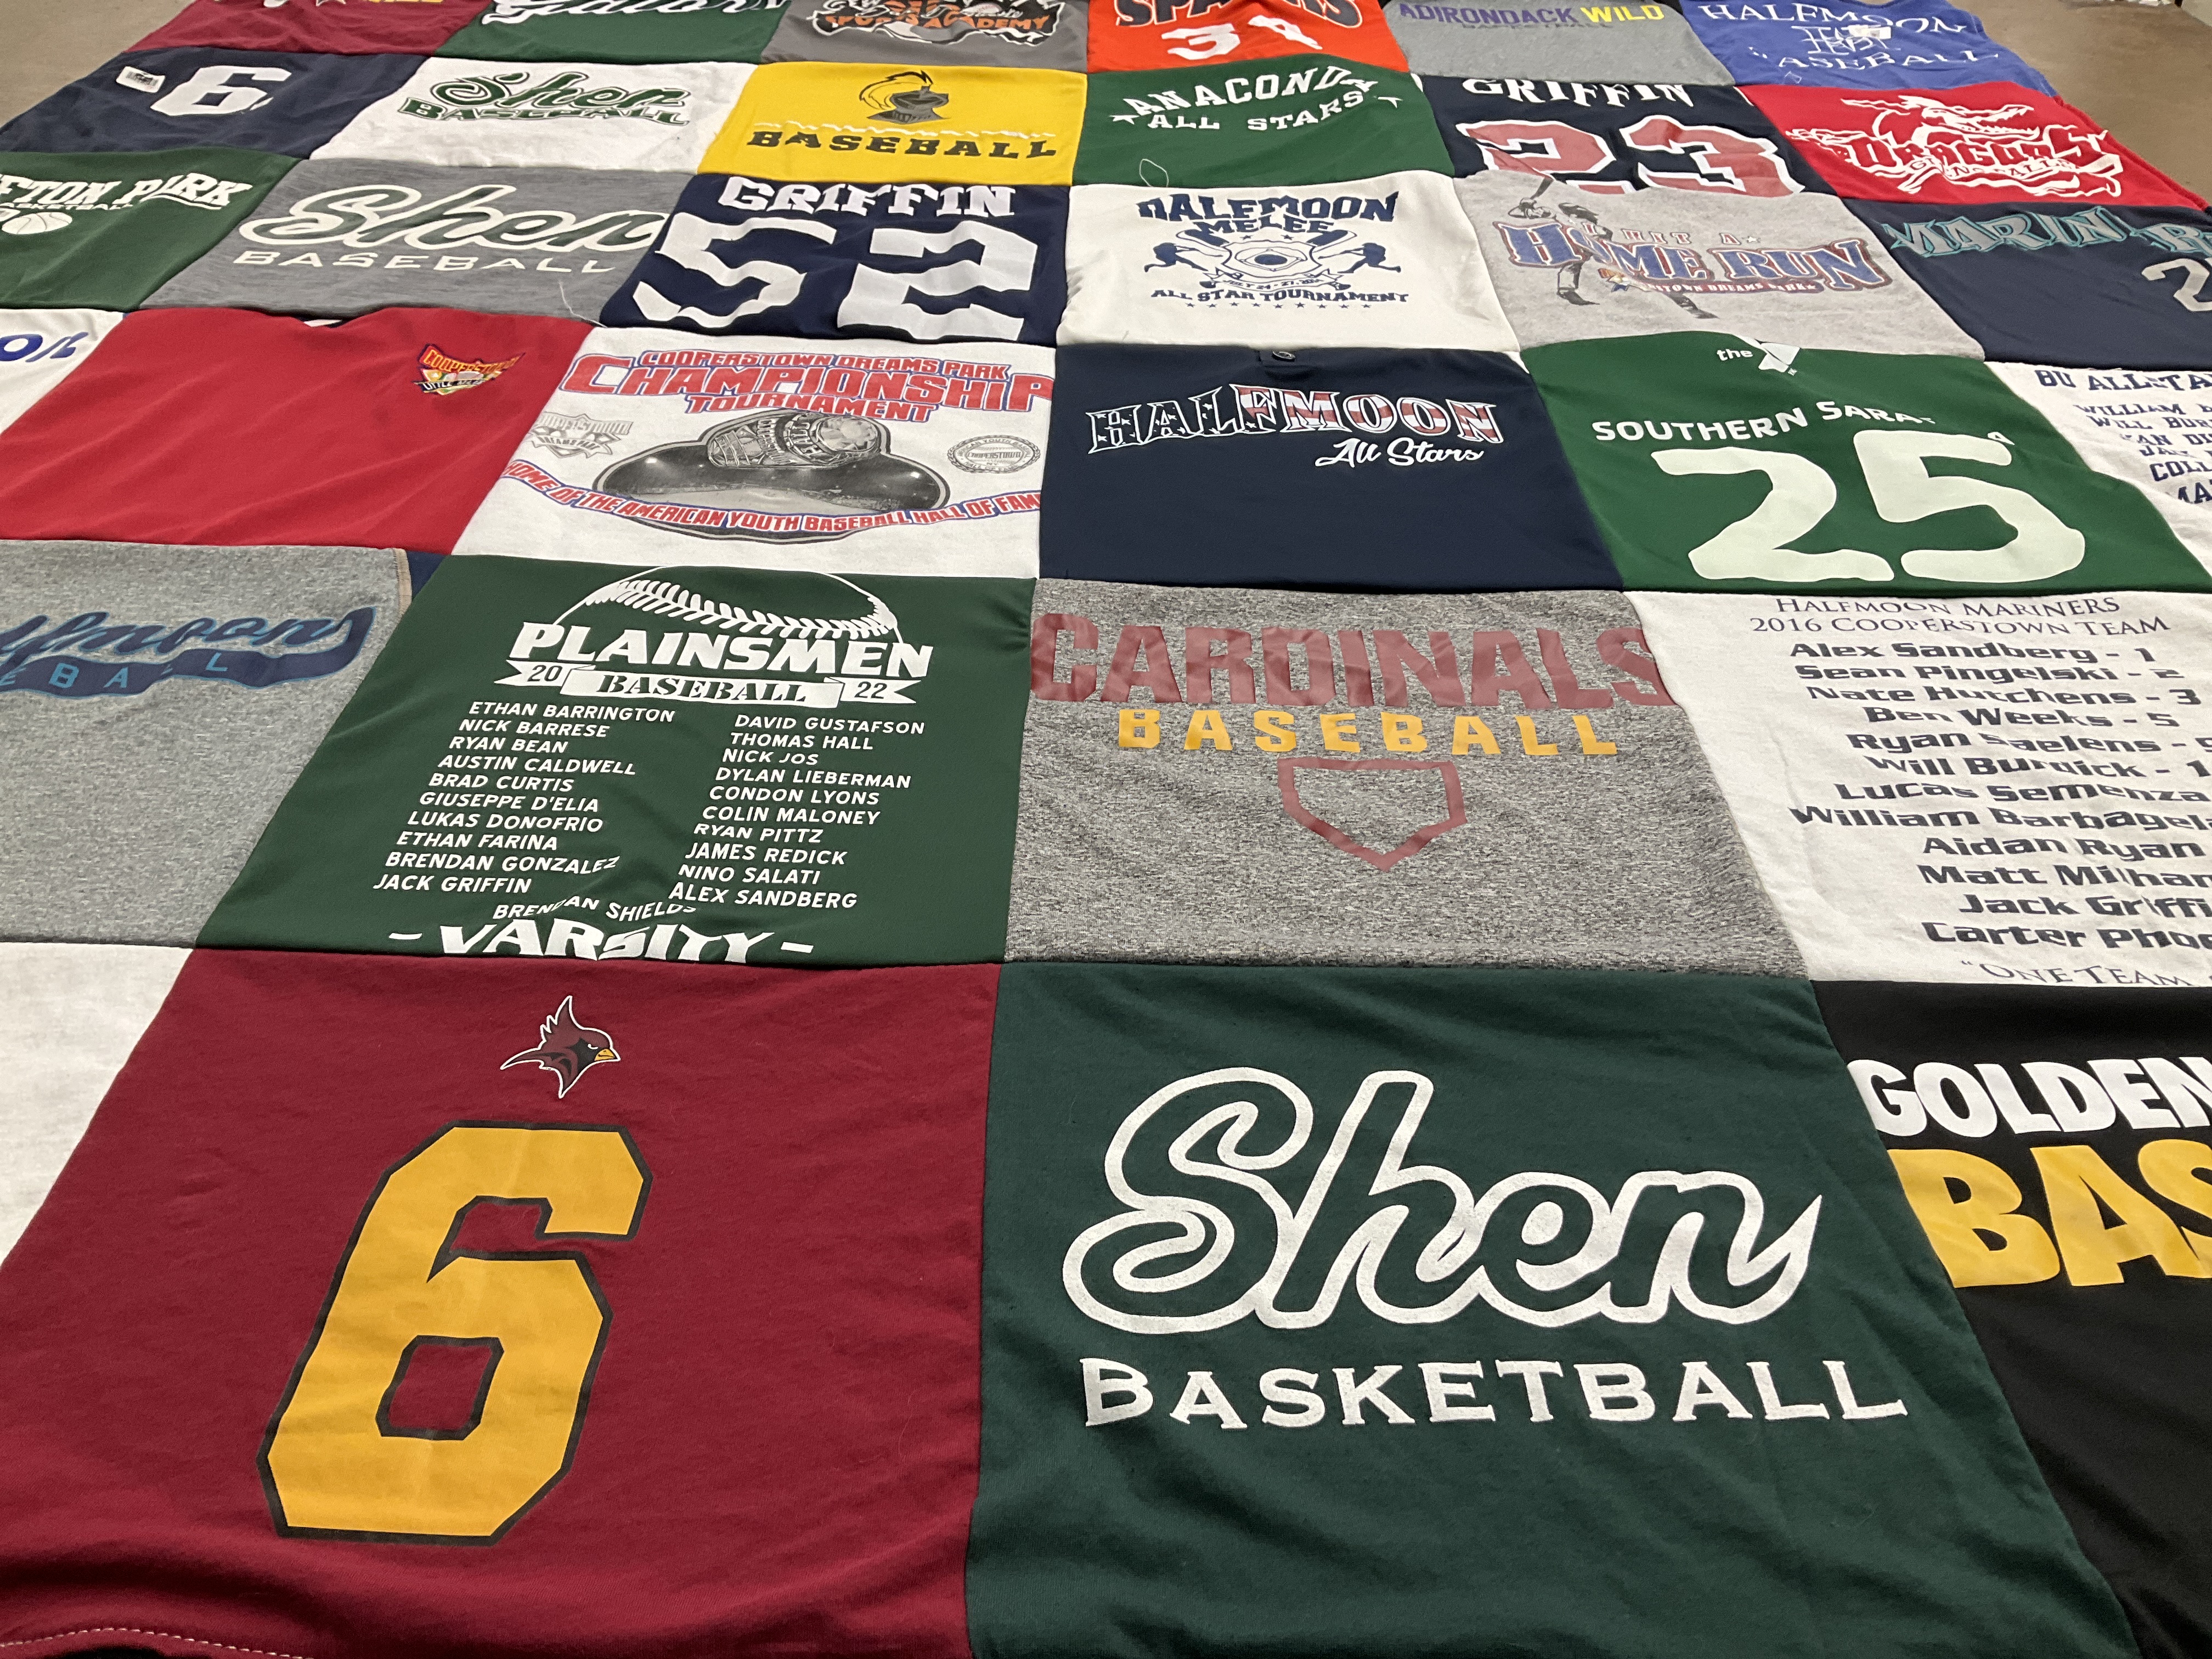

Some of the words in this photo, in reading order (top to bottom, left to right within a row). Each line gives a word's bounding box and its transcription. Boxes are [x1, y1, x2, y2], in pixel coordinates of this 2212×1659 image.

[1400, 3, 1579, 24] ADIRONDACK
[1581, 5, 1665, 22] WILD
[1697, 3, 1967, 33] HALFMOON
[150, 65, 292, 116] 6
[430, 71, 691, 109] Shen
[1462, 77, 1695, 107] GRIFFIN
[1148, 114, 1220, 129] ALL
[1248, 91, 1364, 131] STARS
[747, 131, 1057, 159] BASEBALL
[1455, 115, 1806, 198] 23
[0, 173, 122, 204] FTON
[718, 176, 1015, 218] GRIFFIN
[239, 184, 668, 252] Shen
[1193, 214, 1334, 234] MELEE
[1620, 228, 1692, 245] HIT
[233, 251, 618, 273] BASEBALL
[1708, 238, 1893, 291] RUN
[633, 212, 1038, 341] 52
[1708, 282, 1764, 292] DREAMS
[1150, 289, 1192, 301] ALL
[1198, 289, 1255, 302] STAR
[1260, 289, 1409, 302] TOURNAMENT
[639, 349, 835, 367] COOPERSTOWN
[835, 354, 939, 374] DREAMS
[943, 360, 1012, 380] PARK
[1717, 348, 1753, 361] the
[559, 353, 1054, 412] CHAMPIONSHIP
[685, 392, 939, 423] TOURNAMENT
[2073, 403, 2187, 416] WILLIAM
[1086, 383, 1505, 455] HALFMOON
[1592, 407, 1809, 441] SOUTHERN
[2086, 415, 2153, 430] WILL
[1315, 437, 1382, 467] All
[1387, 437, 1484, 466] Stars
[500, 460, 556, 491] HOME
[546, 485, 584, 505] OF
[573, 490, 623, 514] THE
[614, 499, 728, 528] AMERICAN
[726, 510, 801, 532] YOUTH
[803, 510, 910, 533] BASEBALL
[909, 506, 966, 524] HALL
[963, 498, 997, 518] OF
[1651, 430, 2085, 583] 25
[1775, 598, 1953, 615] HALFMOON
[1962, 596, 2121, 617] MARINERS
[1750, 617, 1822, 632] 2016
[1831, 617, 2071, 635] COOPERSTOWN
[2074, 616, 2172, 636] TEAM
[509, 622, 934, 678] PLAINSMEN
[1031, 612, 1681, 709] CARDINALS
[1790, 642, 1885, 658] Alex
[1891, 641, 2098, 663] Sandberg
[2134, 647, 2156, 662] 1
[527, 664, 563, 682] 20
[596, 674, 807, 702] BASEBALL
[854, 680, 888, 700] 22
[1795, 664, 1906, 679] Sean
[1913, 665, 2119, 685] Pingelski
[2149, 668, 2185, 679] 2
[1805, 686, 1915, 702] Nate
[1923, 685, 2137, 705] Hutchens
[2169, 689, 2202, 705] 3
[469, 701, 538, 716] ETHAN
[543, 704, 675, 722] BARRINGTON
[1862, 706, 1954, 723] Ben
[1956, 707, 2114, 727] Weeks
[2146, 712, 2180, 727] 5
[459, 719, 511, 732] NICK
[516, 721, 610, 738] BARRESE
[735, 714, 796, 729] DAVID
[805, 717, 925, 734] GUSTAFSON
[1117, 708, 1617, 756] BASEBALL
[449, 736, 505, 751] RYAN
[511, 738, 568, 753] BEAN
[730, 732, 815, 748] THOMAS
[822, 736, 874, 750] HALL
[1845, 732, 1972, 753] Ryan
[1977, 732, 2162, 752] Saelens
[438, 755, 515, 769] AUSTIN
[524, 758, 636, 775] CALDWELL
[722, 748, 774, 763] NICK
[778, 753, 819, 765] JOS
[1863, 755, 1956, 775] Will
[428, 773, 488, 788] BRAD
[496, 775, 575, 792] CURTIS
[715, 767, 785, 782] DYLAN
[793, 770, 912, 788] LIEBERMAN
[419, 792, 526, 809] GIUSEPPE
[531, 795, 599, 812] D'ELIA
[709, 786, 803, 802] CONDON
[810, 789, 879, 805] LYONS
[1833, 782, 1979, 800] Lucas
[1985, 783, 2211, 802] Semenza
[408, 811, 481, 828] LUKAS
[486, 814, 603, 832] DONOFRIO
[702, 806, 769, 822] COLIN
[776, 808, 881, 825] MALONEY
[1787, 805, 1980, 826] William
[396, 831, 473, 848] ETHAN
[478, 834, 558, 850] FARINA
[693, 823, 752, 839] RYAN
[760, 827, 823, 843] PITTZ
[685, 842, 757, 860] JAMES
[764, 847, 848, 865] REDICK
[1922, 837, 2069, 855] Aidan
[2074, 838, 2207, 862] Ryan
[385, 852, 494, 871] BRENDAN
[501, 856, 620, 874] GONZALEZ
[678, 864, 734, 882] NINO
[742, 867, 821, 884] SALATI
[373, 874, 435, 891] JACK
[441, 876, 532, 894] GRIFFIN
[1916, 864, 2049, 885] Matt
[668, 882, 729, 904] ALEX
[735, 889, 857, 909] SANDBERG
[1958, 894, 2081, 915] Jack
[492, 895, 600, 919] BRENDAN
[439, 918, 775, 963] VARSITY
[1921, 921, 2087, 948] Carter
[1847, 1056, 2212, 1137] GOLDEN
[1062, 1066, 1823, 1334] Shen
[255, 1120, 653, 1547] 6
[1080, 1357, 1909, 1430] BASKETBALL
